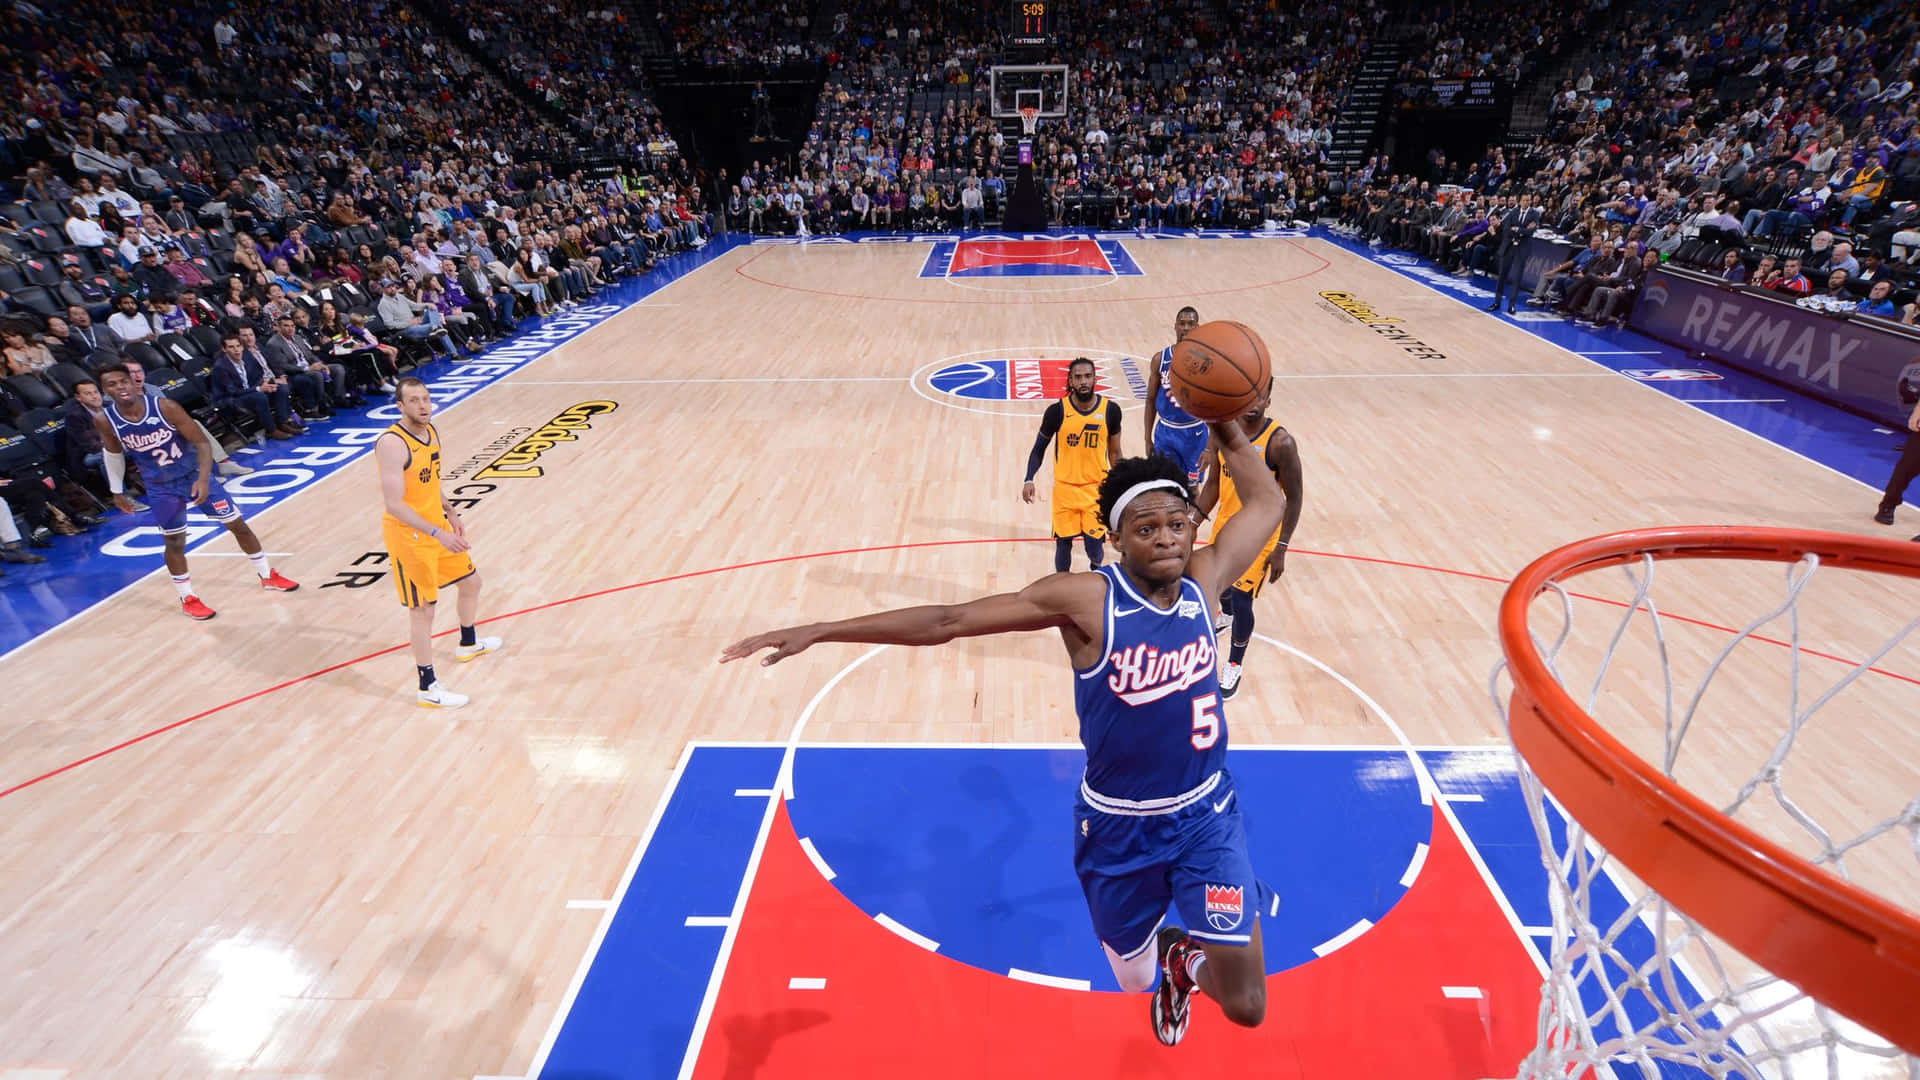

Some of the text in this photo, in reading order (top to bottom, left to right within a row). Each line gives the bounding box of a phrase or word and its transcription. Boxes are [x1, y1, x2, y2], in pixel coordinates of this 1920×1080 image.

[1023, 3, 1044, 16] 5:09
[1025, 17, 1041, 33] 11
[1368, 324, 1447, 360] CENTER
[1681, 296, 1862, 391] RE/MAX
[366, 304, 621, 420] SACRAMENTO
[1015, 360, 1044, 399] KINGS
[122, 428, 173, 453] Kings
[152, 442, 183, 467] 24
[440, 427, 532, 481] Credit Union
[1084, 432, 1098, 449] 10
[1108, 635, 1217, 706] Kings
[1190, 691, 1220, 751] 5
[1207, 902, 1241, 912] KINGS
